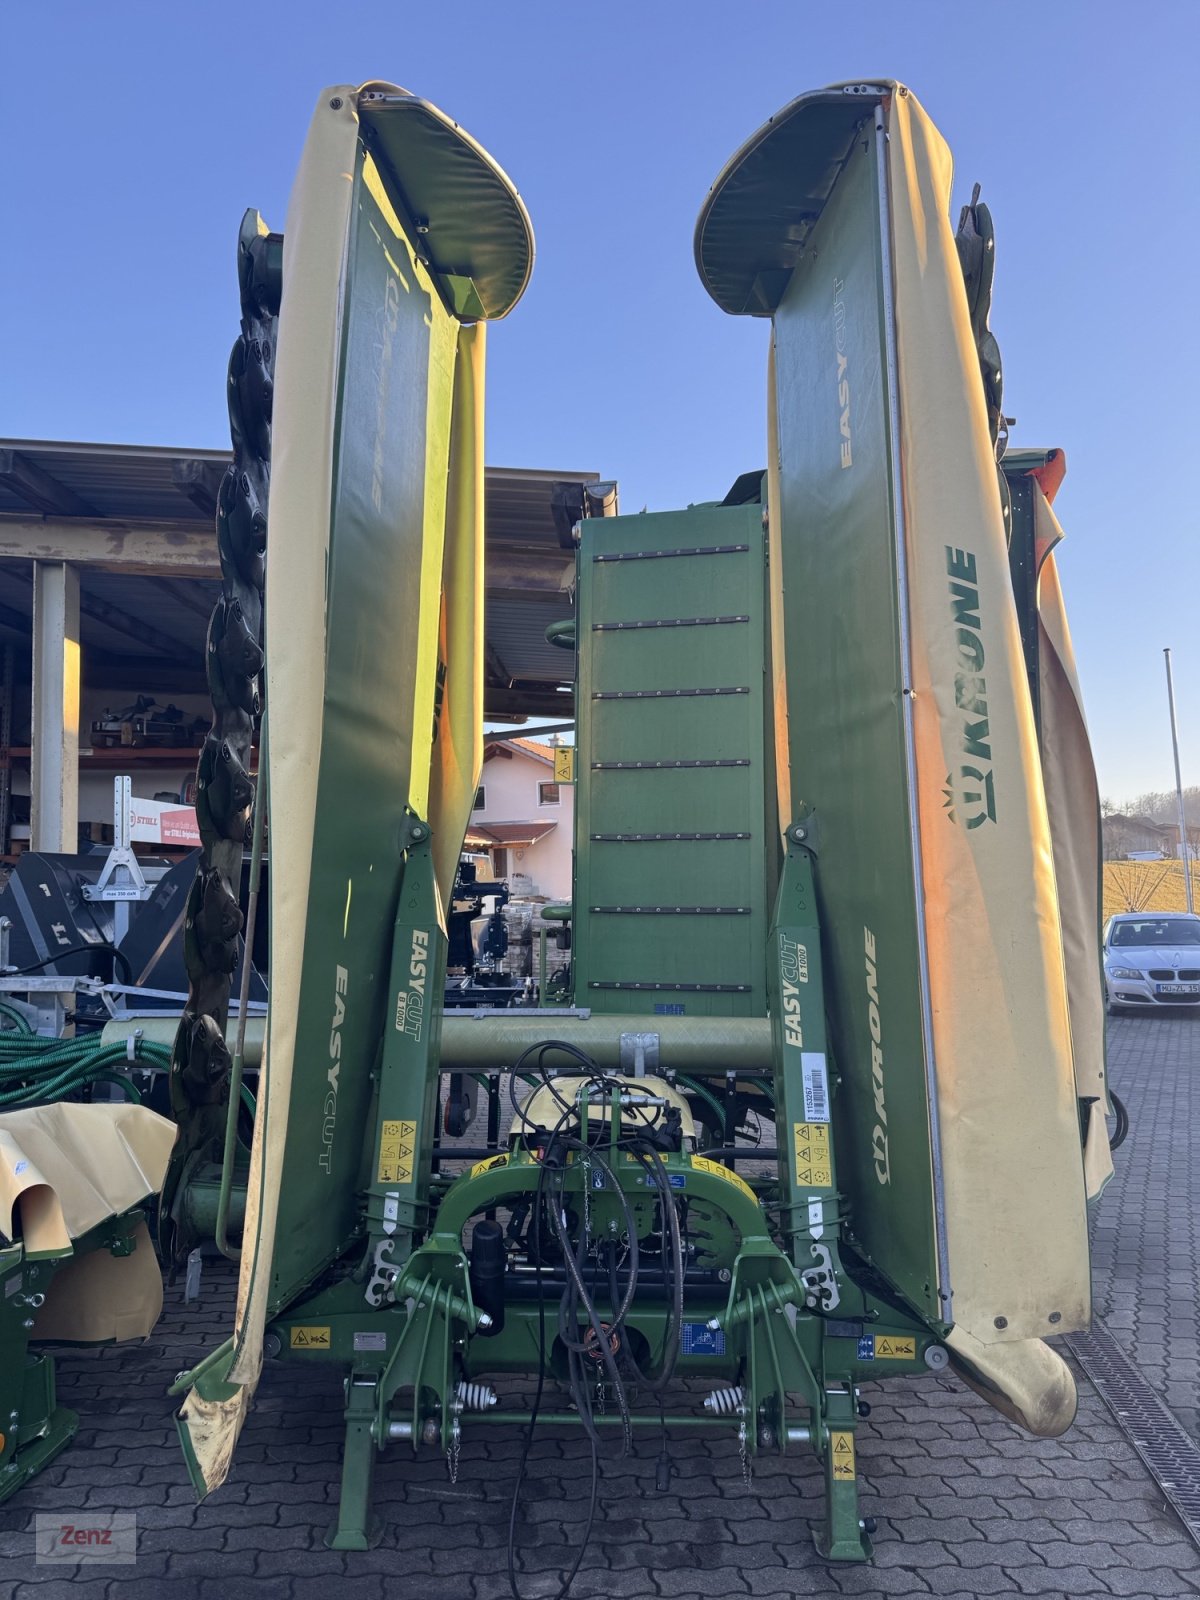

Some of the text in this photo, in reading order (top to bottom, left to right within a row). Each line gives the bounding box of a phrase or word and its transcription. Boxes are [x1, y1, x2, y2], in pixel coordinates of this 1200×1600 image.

[944, 544, 992, 761] KRONE
[396, 1005, 405, 1027] 1000
[404, 929, 429, 1042] EASYCUT
[780, 933, 803, 1048] EASYCUT
[799, 948, 808, 979] B 1000
[318, 964, 349, 1175] EASYCUT
[864, 925, 888, 1126] KRONE
[806, 1087, 814, 1113] 1153267
